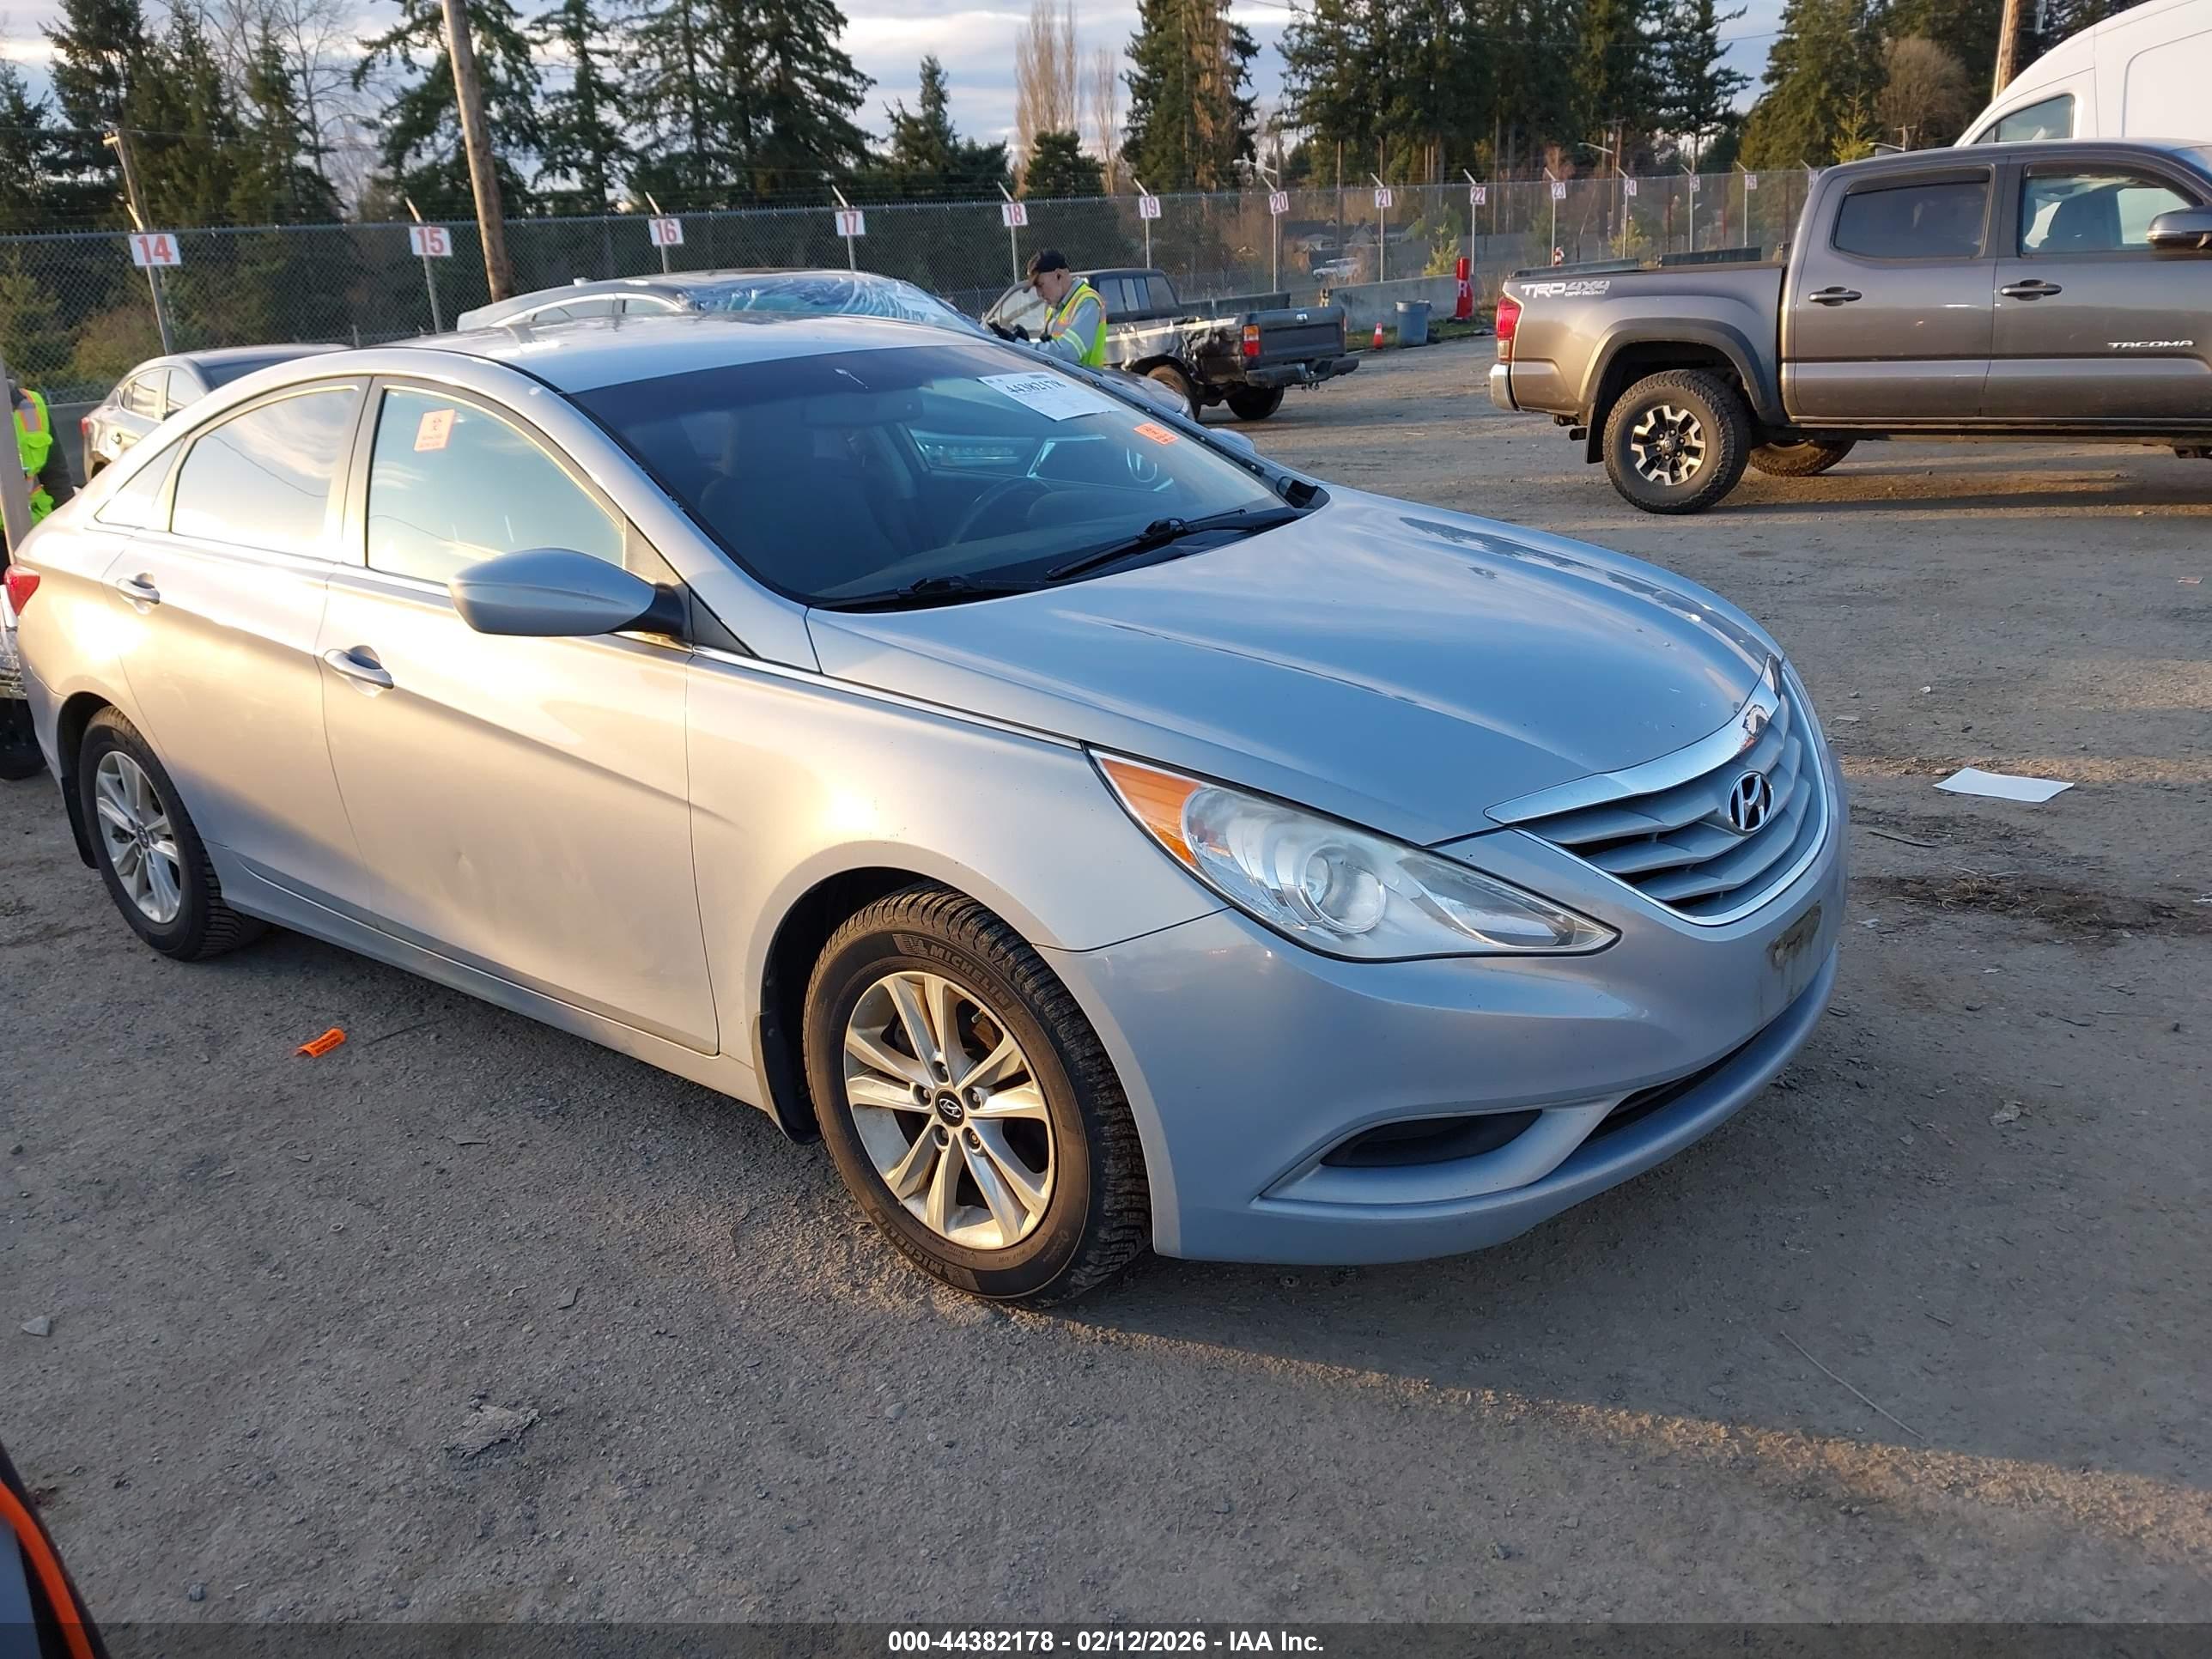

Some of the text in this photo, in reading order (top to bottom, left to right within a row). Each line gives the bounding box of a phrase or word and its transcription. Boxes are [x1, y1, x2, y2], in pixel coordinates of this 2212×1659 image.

[1378, 190, 1389, 206] 21
[1473, 188, 1484, 203] 22
[1553, 183, 1565, 198] 23
[1142, 198, 1157, 216] 19
[1272, 192, 1287, 212] 20
[842, 212, 857, 234] 17
[1006, 205, 1023, 224] 18
[655, 219, 677, 243] 16
[137, 235, 172, 264] 14
[416, 228, 444, 254] 15
[1520, 283, 1566, 298] TRD
[2107, 340, 2194, 349] TACOMA
[1006, 380, 1066, 393] 44382178
[930, 945, 1011, 1010] MICHELIN
[872, 1210, 944, 1274] MICHELIN
